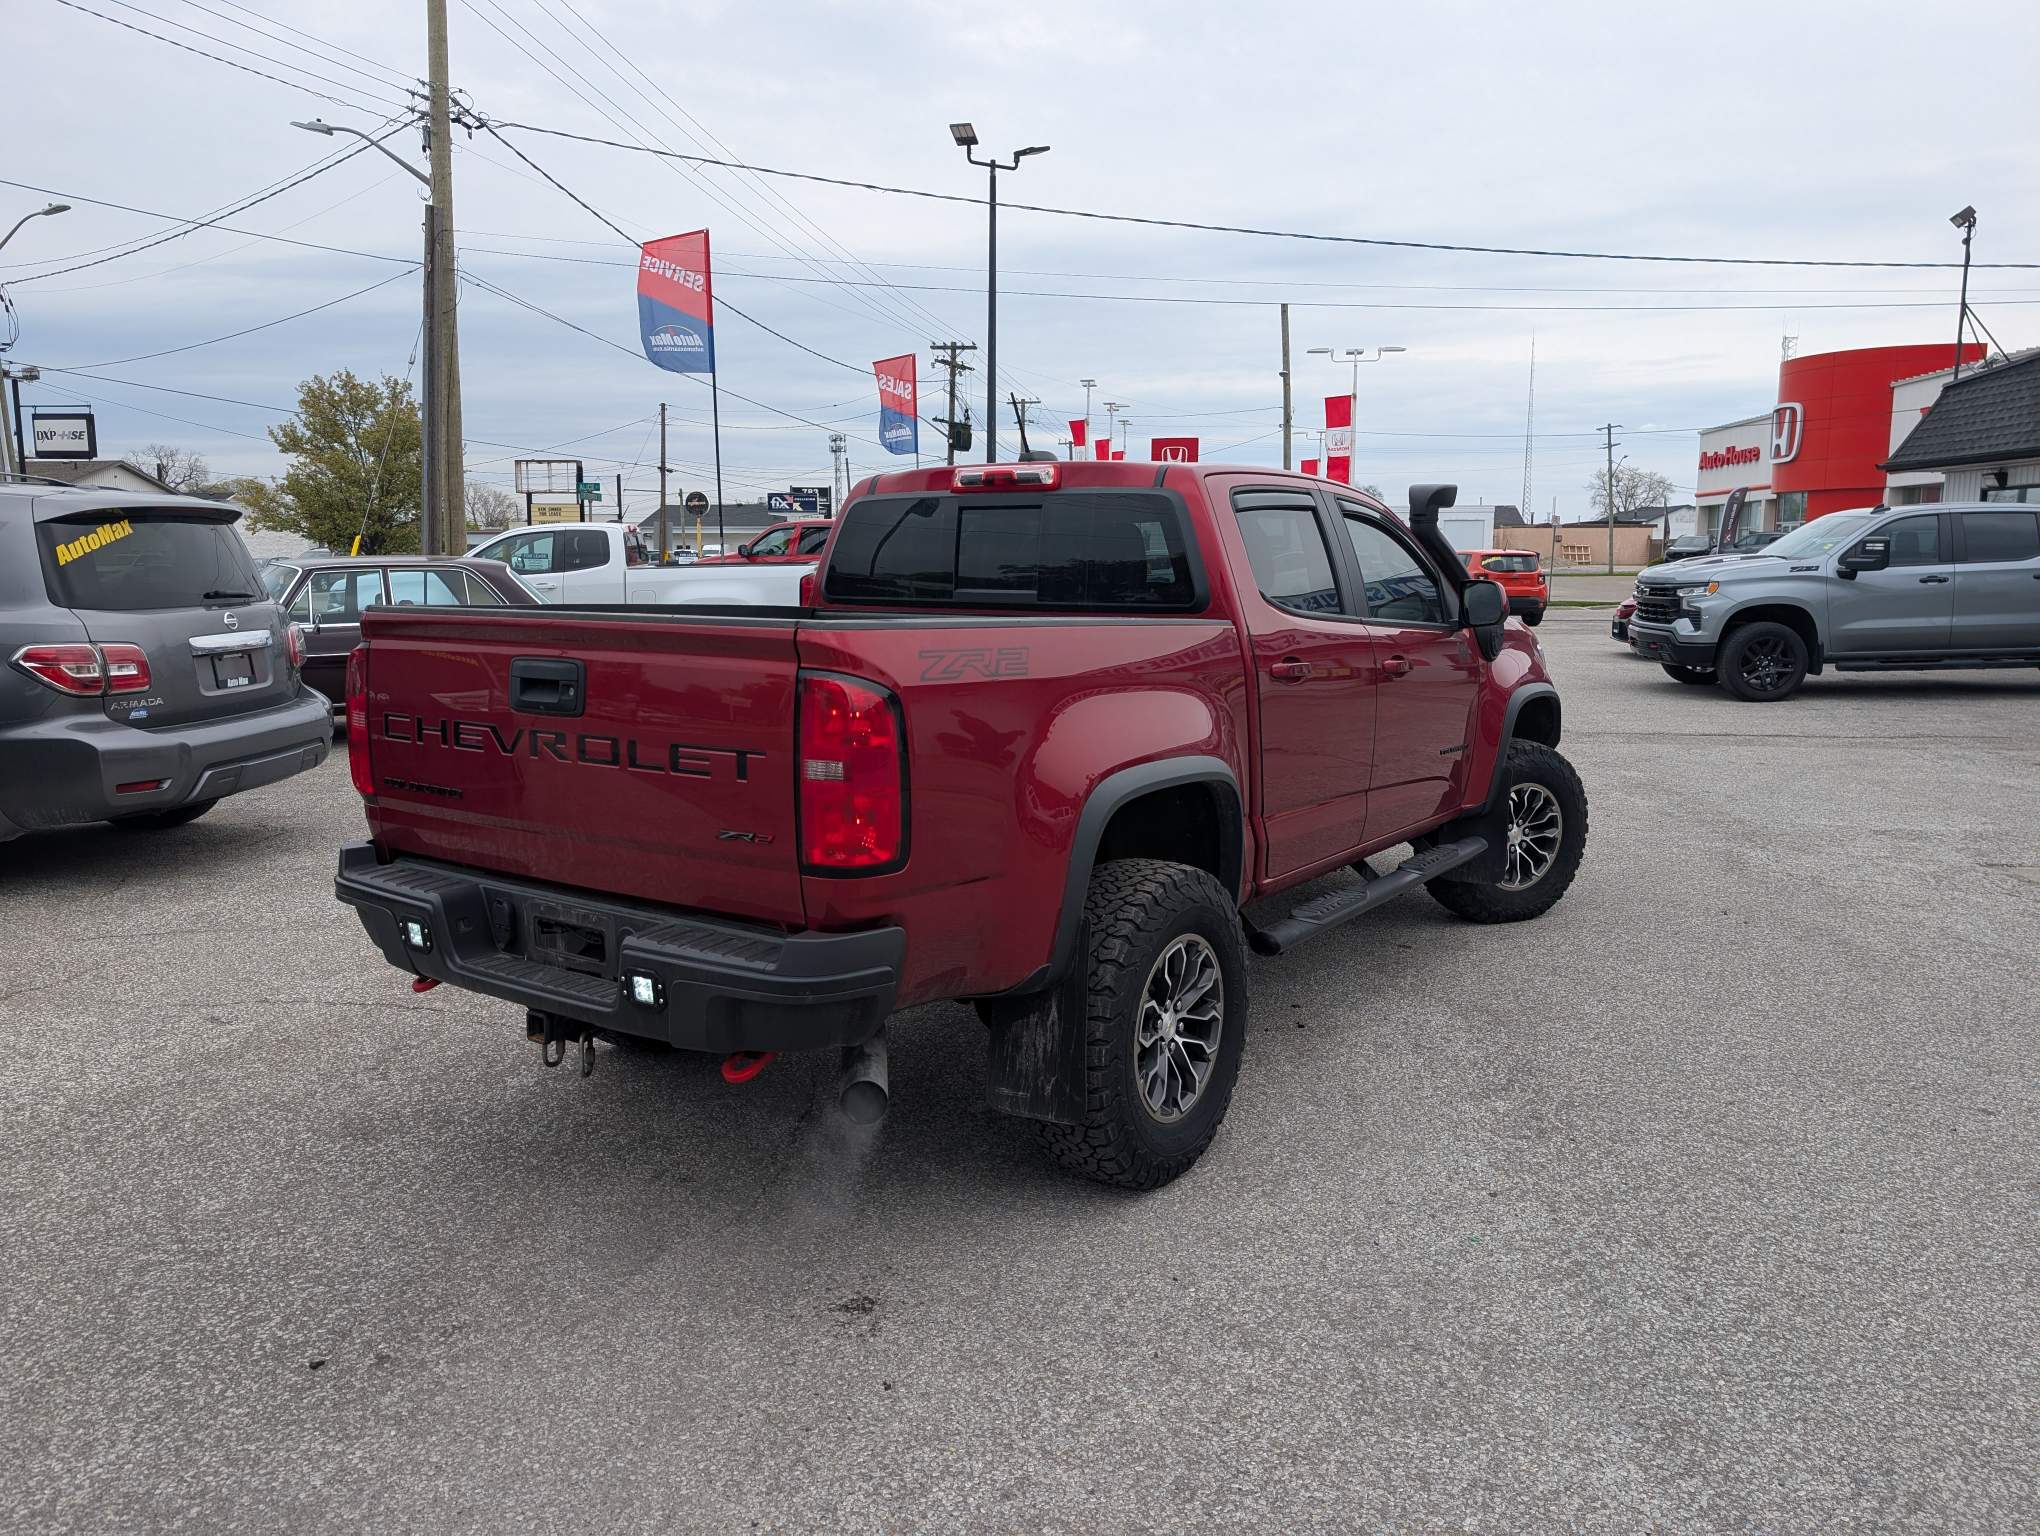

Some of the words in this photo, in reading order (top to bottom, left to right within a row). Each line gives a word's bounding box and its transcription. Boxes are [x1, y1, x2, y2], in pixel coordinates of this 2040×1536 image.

[1699, 451, 1725, 471] Auto
[1724, 445, 1760, 465] House
[56, 519, 134, 567] AutoMax
[918, 647, 1030, 682] ZR2
[110, 698, 164, 711] ARMADA
[384, 713, 766, 783] CHEVROLET
